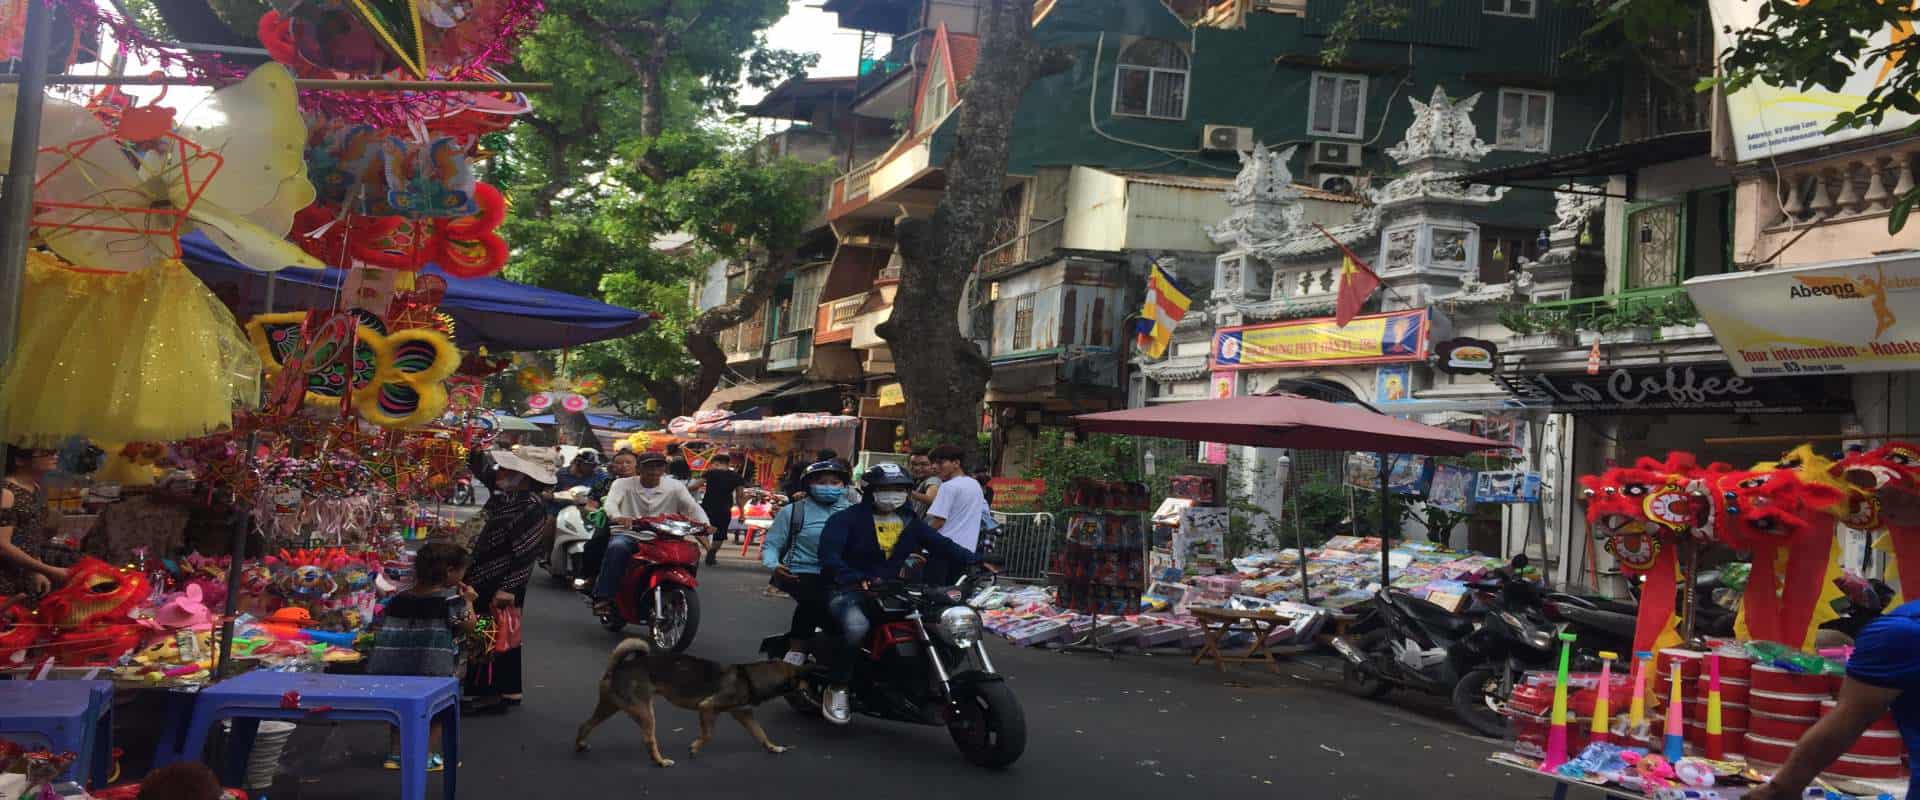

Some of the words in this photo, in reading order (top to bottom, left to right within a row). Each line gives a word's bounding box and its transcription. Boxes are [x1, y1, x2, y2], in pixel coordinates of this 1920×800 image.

[1790, 281, 1856, 300] Abeona
[1737, 349, 1768, 363] Tour
[1772, 343, 1857, 361] information
[1868, 339, 1920, 357] Hotels
[1607, 366, 1754, 404] Coffee
